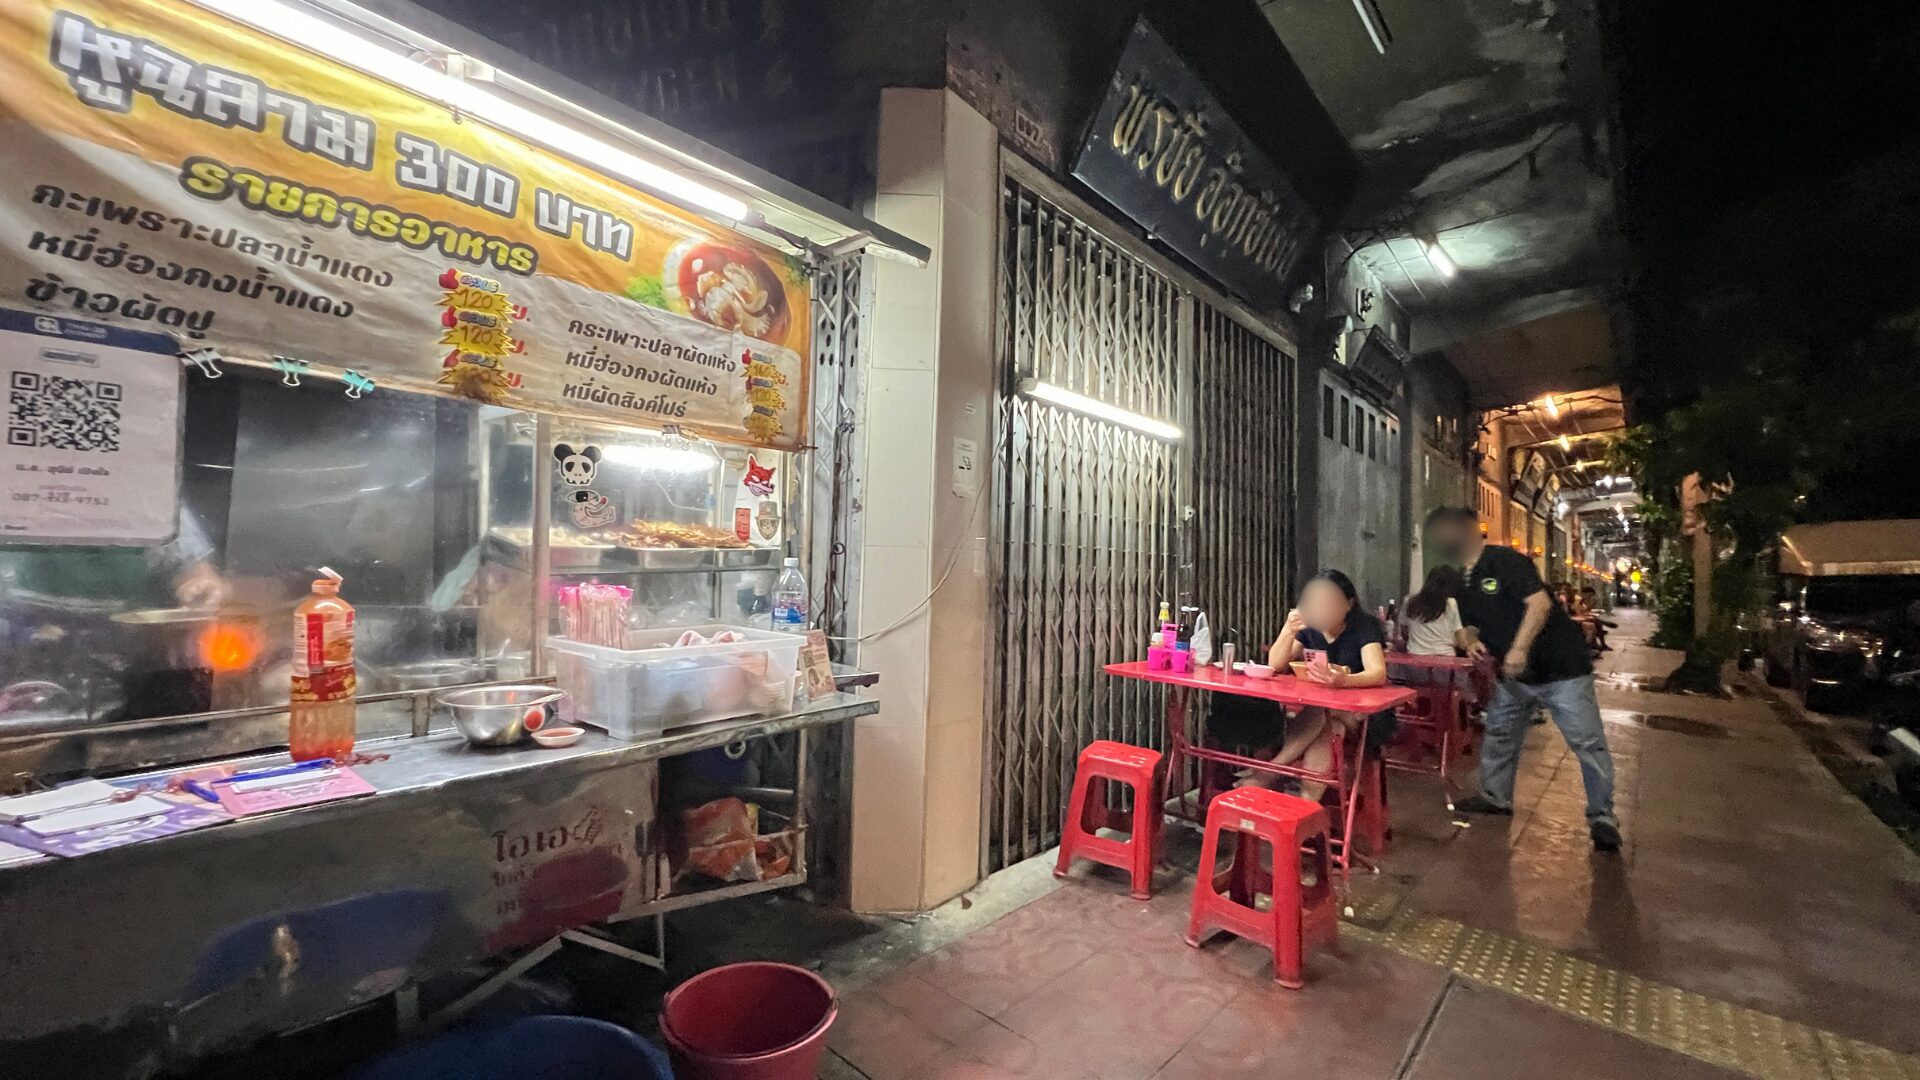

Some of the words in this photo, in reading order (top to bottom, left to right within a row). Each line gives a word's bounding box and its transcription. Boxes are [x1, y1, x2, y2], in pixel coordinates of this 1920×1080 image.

[53, 13, 372, 168] หูฉลาม
[398, 134, 517, 215] 300
[536, 189, 631, 259] บาท
[182, 158, 537, 274] รายการอาหาร
[28, 227, 354, 318] หมี่ฮ่องกงน้ำแดง
[454, 288, 493, 310] 120
[26, 273, 215, 339] ข้าวผัดปู
[461, 326, 493, 344] 120
[568, 319, 737, 373] กระเพาะปลาผัดแห้ง
[562, 376, 688, 418] หมี่ผัดสิงค์โปร์
[565, 345, 718, 396] หมี่ฮ่องกงผัดแห้ง
